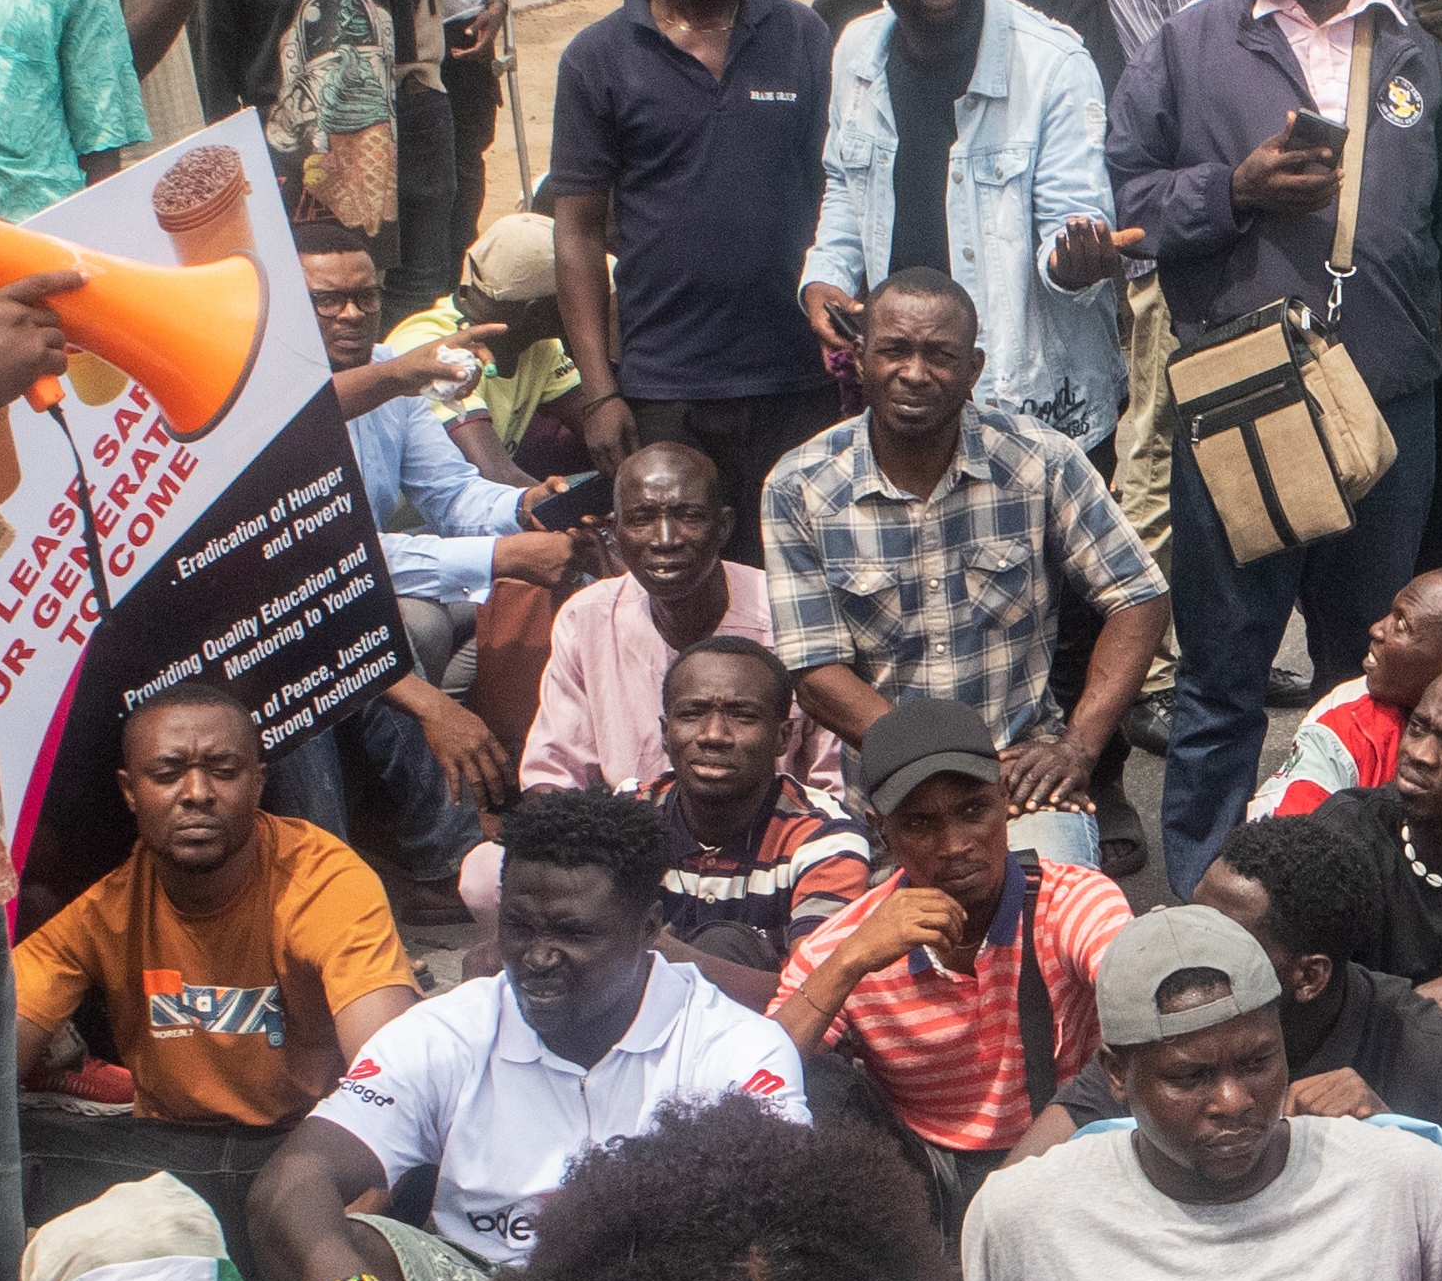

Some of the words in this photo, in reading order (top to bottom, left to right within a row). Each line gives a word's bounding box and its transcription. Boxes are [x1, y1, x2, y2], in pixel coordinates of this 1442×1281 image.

[58, 586, 103, 648] TO
[108, 444, 199, 578] COME
[176, 513, 268, 580] Eradication
[270, 498, 286, 522] of
[287, 466, 346, 513] Hunger
[262, 528, 293, 560] and
[295, 491, 354, 542] Poverty
[123, 652, 204, 713] Providing
[203, 614, 260, 663] Quality
[260, 566, 337, 627] Education
[338, 542, 368, 575] and
[223, 618, 306, 682] Mentoring
[304, 606, 323, 628] to
[322, 571, 376, 616] Youths
[264, 692, 279, 717] of
[282, 662, 336, 708] Peace,
[336, 623, 391, 671] Justice
[260, 707, 315, 751] Strong
[313, 649, 399, 716] Institutions
